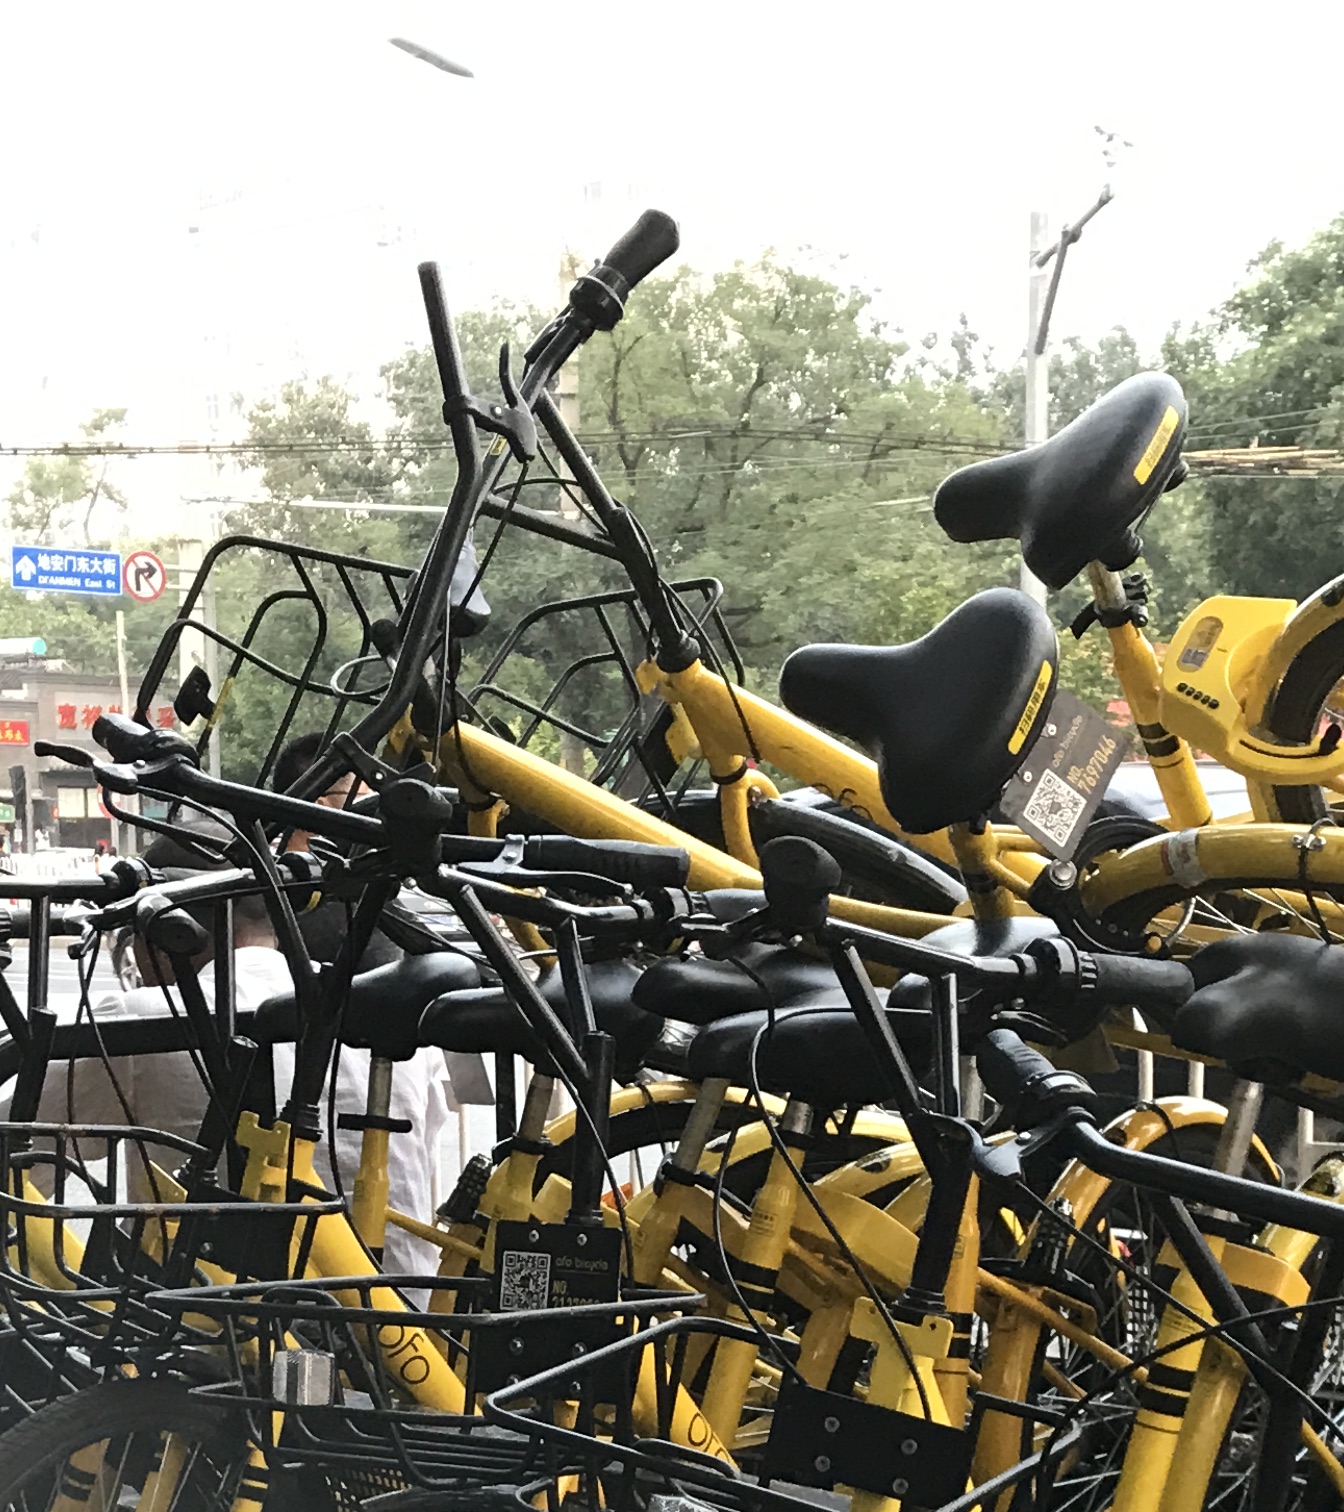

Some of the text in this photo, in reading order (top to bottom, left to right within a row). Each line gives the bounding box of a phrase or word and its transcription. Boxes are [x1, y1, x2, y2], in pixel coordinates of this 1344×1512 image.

[37, 553, 116, 575] 地安门东大街
[1067, 765, 1084, 785] NO.
[1077, 734, 1116, 794] 7697046
